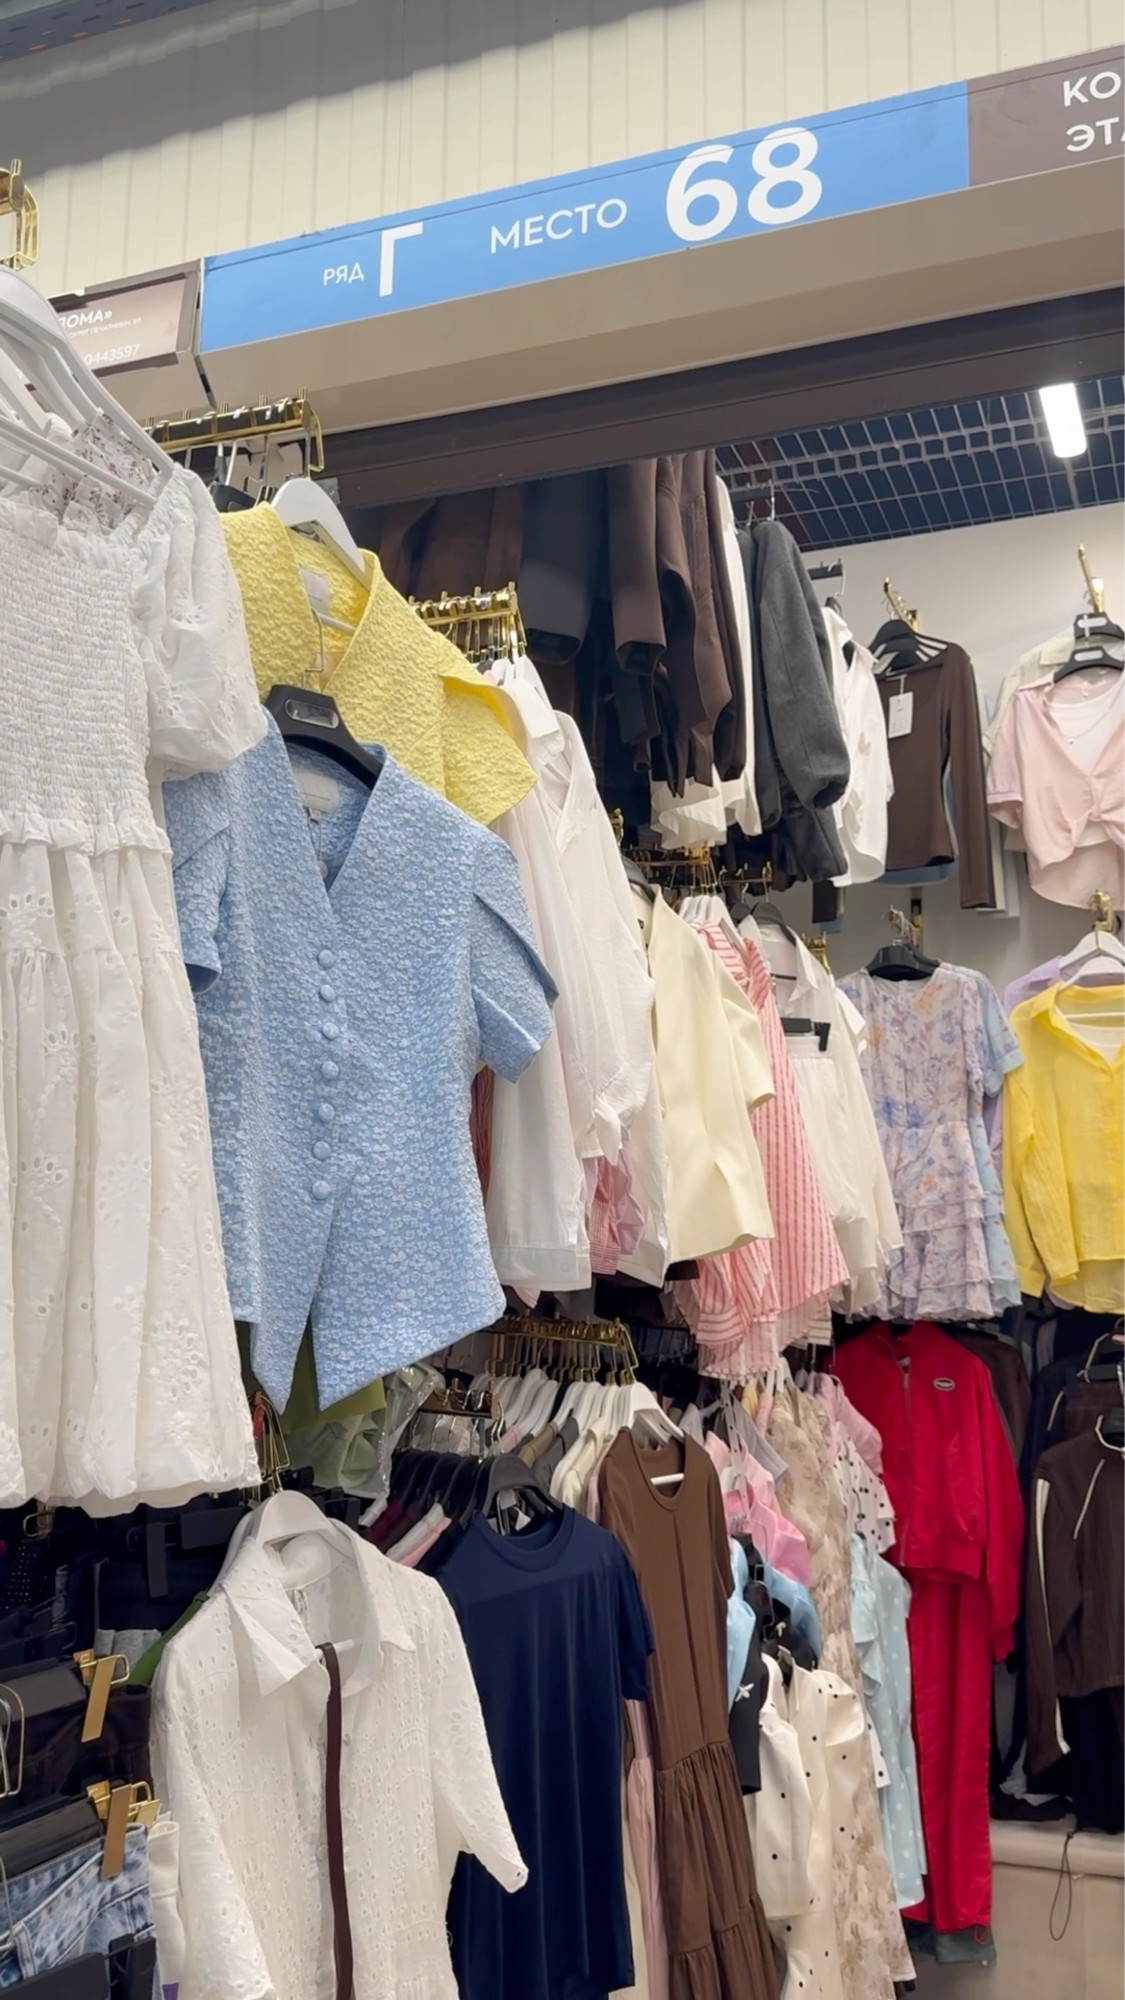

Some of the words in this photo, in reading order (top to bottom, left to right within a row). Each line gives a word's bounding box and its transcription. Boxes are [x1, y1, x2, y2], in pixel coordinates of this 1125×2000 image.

[1066, 117, 1124, 152] ЭТ
[323, 261, 365, 287] РЯД
[379, 221, 424, 297] Г
[489, 198, 628, 254] МЕСТО
[666, 126, 823, 242] 68
